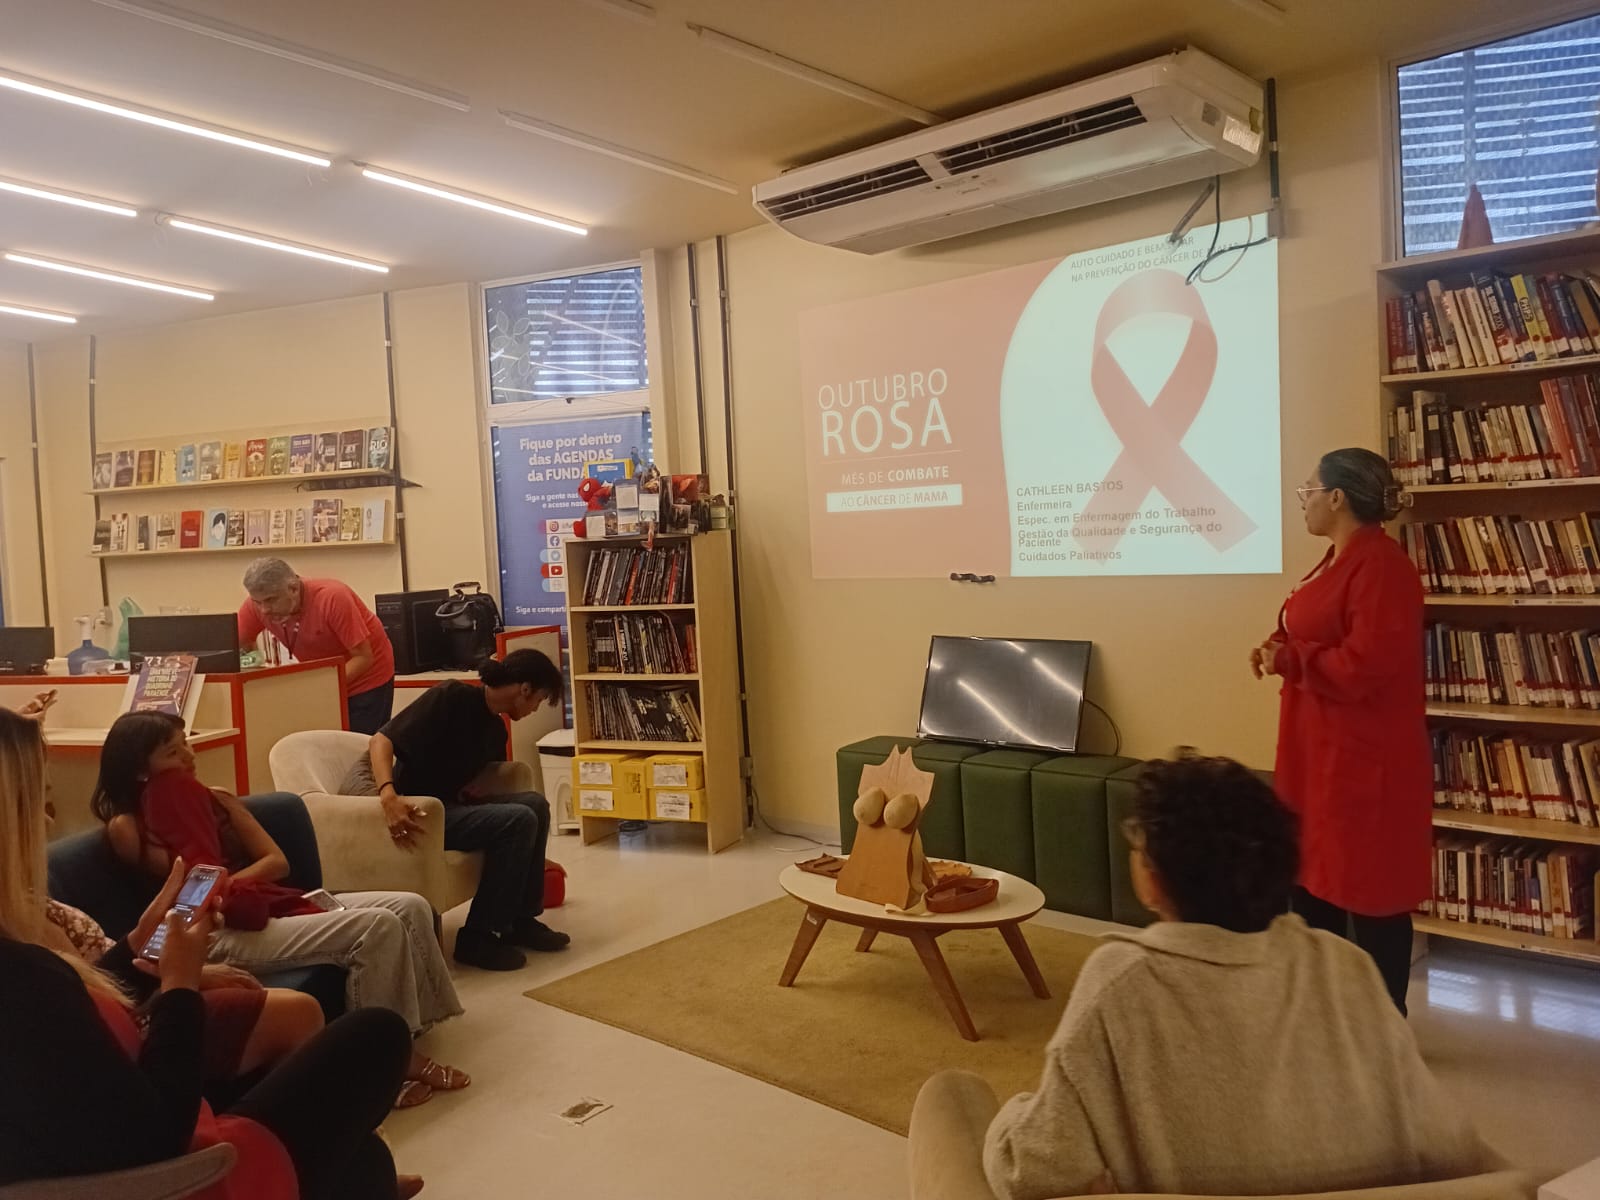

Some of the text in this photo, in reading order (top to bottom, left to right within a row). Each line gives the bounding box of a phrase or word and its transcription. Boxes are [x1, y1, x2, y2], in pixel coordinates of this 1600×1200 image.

[1071, 257, 1093, 269] AUTO
[1095, 250, 1135, 265] CUIDADO
[1137, 248, 1142, 257] E
[1071, 271, 1083, 283] NA
[1085, 261, 1136, 279] PREVENÇÃO
[1138, 259, 1151, 270] DO
[1192, 249, 1203, 259] DE
[818, 368, 948, 410] OUTUBRO
[822, 397, 952, 456] ROSA
[519, 432, 622, 452] Fique por dentro
[529, 448, 614, 466] das AGENDAS
[527, 469, 544, 482] da
[868, 471, 883, 484] DE
[887, 465, 949, 482] COMBATE
[525, 493, 539, 502] Siga
[546, 493, 565, 502] gente
[899, 492, 912, 504] DE
[913, 490, 949, 503] MAMA
[1016, 480, 1123, 497] CATHLEEN BASTOS
[1017, 501, 1072, 512] Enfermeira
[1018, 506, 1216, 527] Espec. em Enfermagem do Trabalho
[1018, 522, 1222, 540] Gestão da Qualidade e Segurança do
[1018, 538, 1061, 548] Paciente
[1019, 551, 1122, 561] Cuidados Paliativos
[515, 605, 530, 615] Siga
